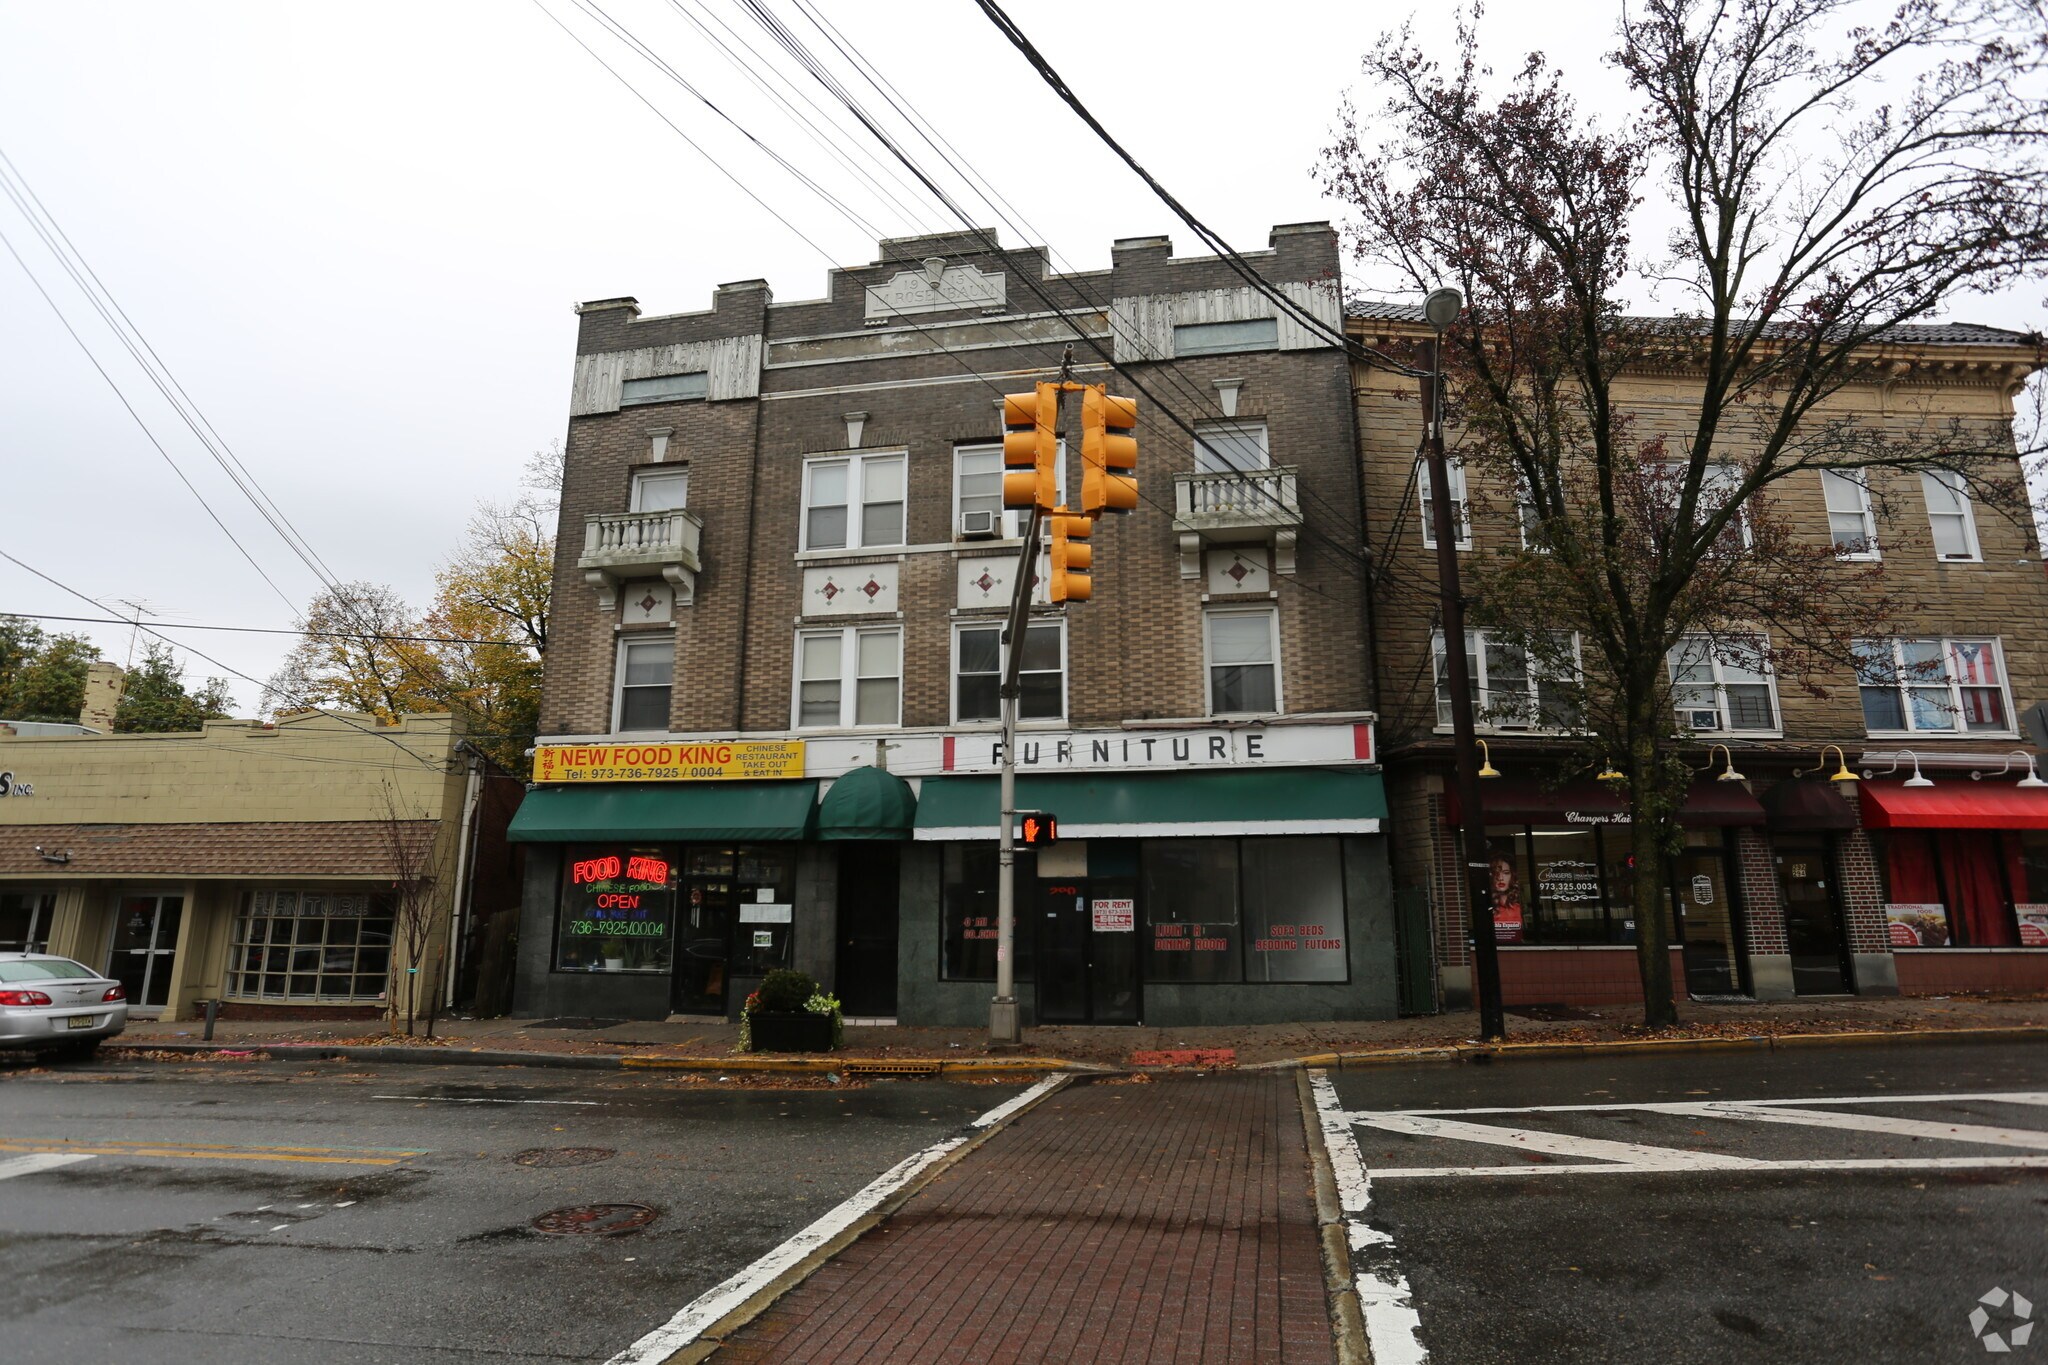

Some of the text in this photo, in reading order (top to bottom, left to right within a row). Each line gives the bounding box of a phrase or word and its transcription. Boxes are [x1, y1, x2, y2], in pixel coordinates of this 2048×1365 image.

[746, 744, 787, 753] CHINESE
[991, 733, 1266, 766] FURNITURE
[560, 746, 731, 766] NEW FOOD KING
[735, 752, 798, 761] RESTAURANT
[742, 760, 788, 769] TAKE OUT
[564, 768, 587, 780] Tel:
[591, 767, 679, 779] 973-736-7925
[691, 766, 723, 778] 0004
[753, 769, 770, 777] EAT
[1565, 811, 1609, 826] Changers
[573, 856, 669, 884] FOOD KING
[585, 883, 650, 894] CHINESE FOOD
[1539, 882, 1598, 891] 973.325.0034
[597, 893, 640, 909] OPEN
[1094, 901, 1131, 909] FOR RENT
[1270, 925, 1325, 937] SOFA BEDS
[1155, 938, 1227, 951] DINING ROOM
[1255, 939, 1341, 952] BEDDING FUTONS
